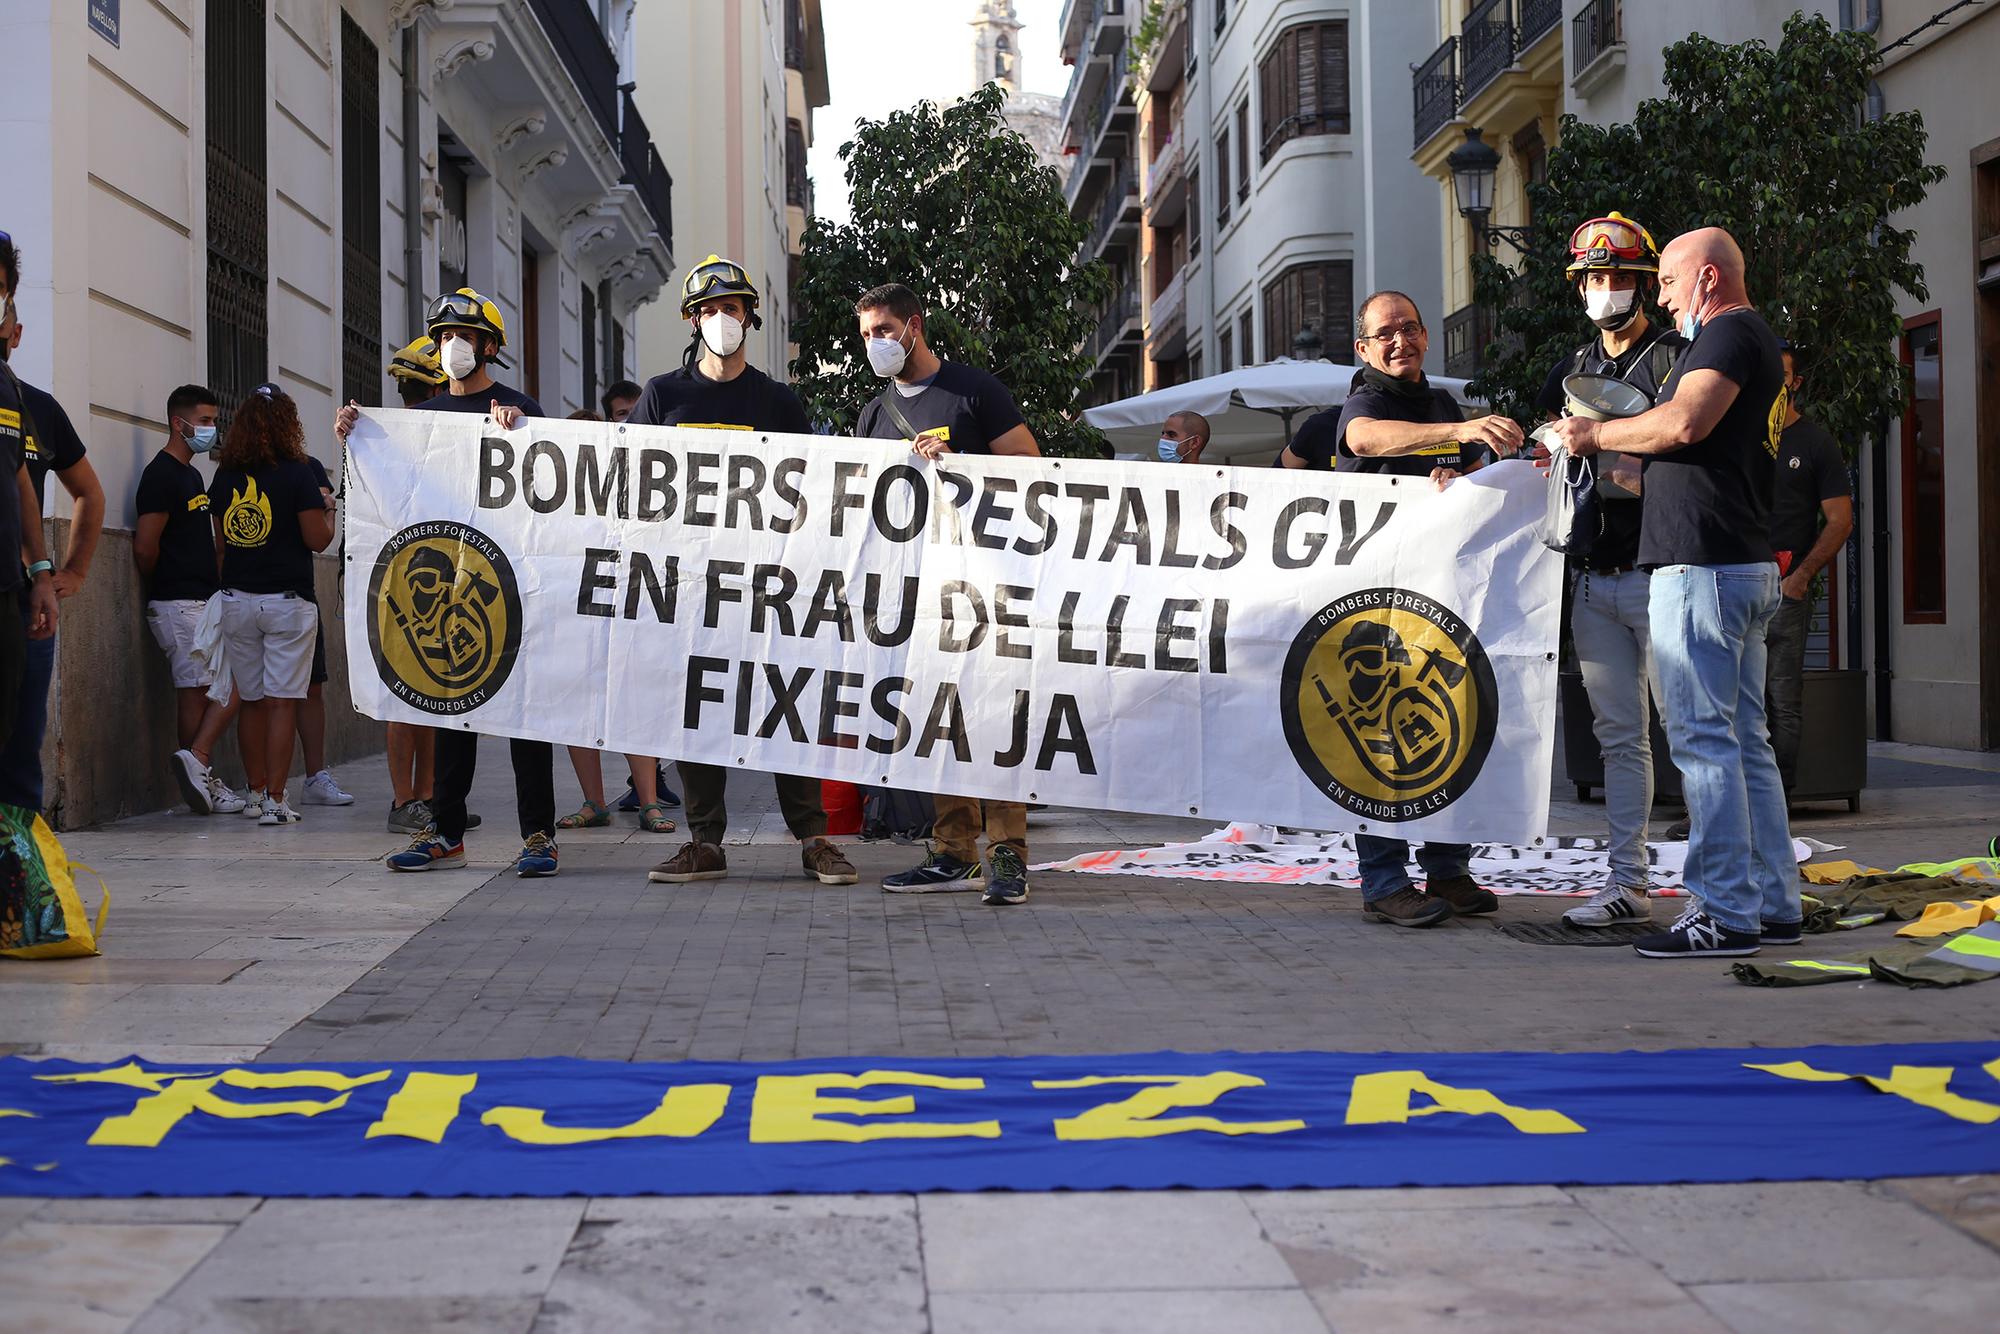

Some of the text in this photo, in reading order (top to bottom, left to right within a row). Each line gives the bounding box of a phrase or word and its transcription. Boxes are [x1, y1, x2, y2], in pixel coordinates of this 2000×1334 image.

[478, 437, 1398, 570] BOMBERS FORESTALS GV
[390, 524, 499, 561] BOMBERS FORESTALS
[576, 547, 1231, 675] EN FRAU DE LLEI
[1318, 592, 1459, 634] BOMBERS FORESTALS
[393, 680, 487, 712] EN FRAUDE DE LEY
[682, 655, 1098, 775] FIXESA JA
[1327, 781, 1449, 818] EN FRAUDE DE LEY
